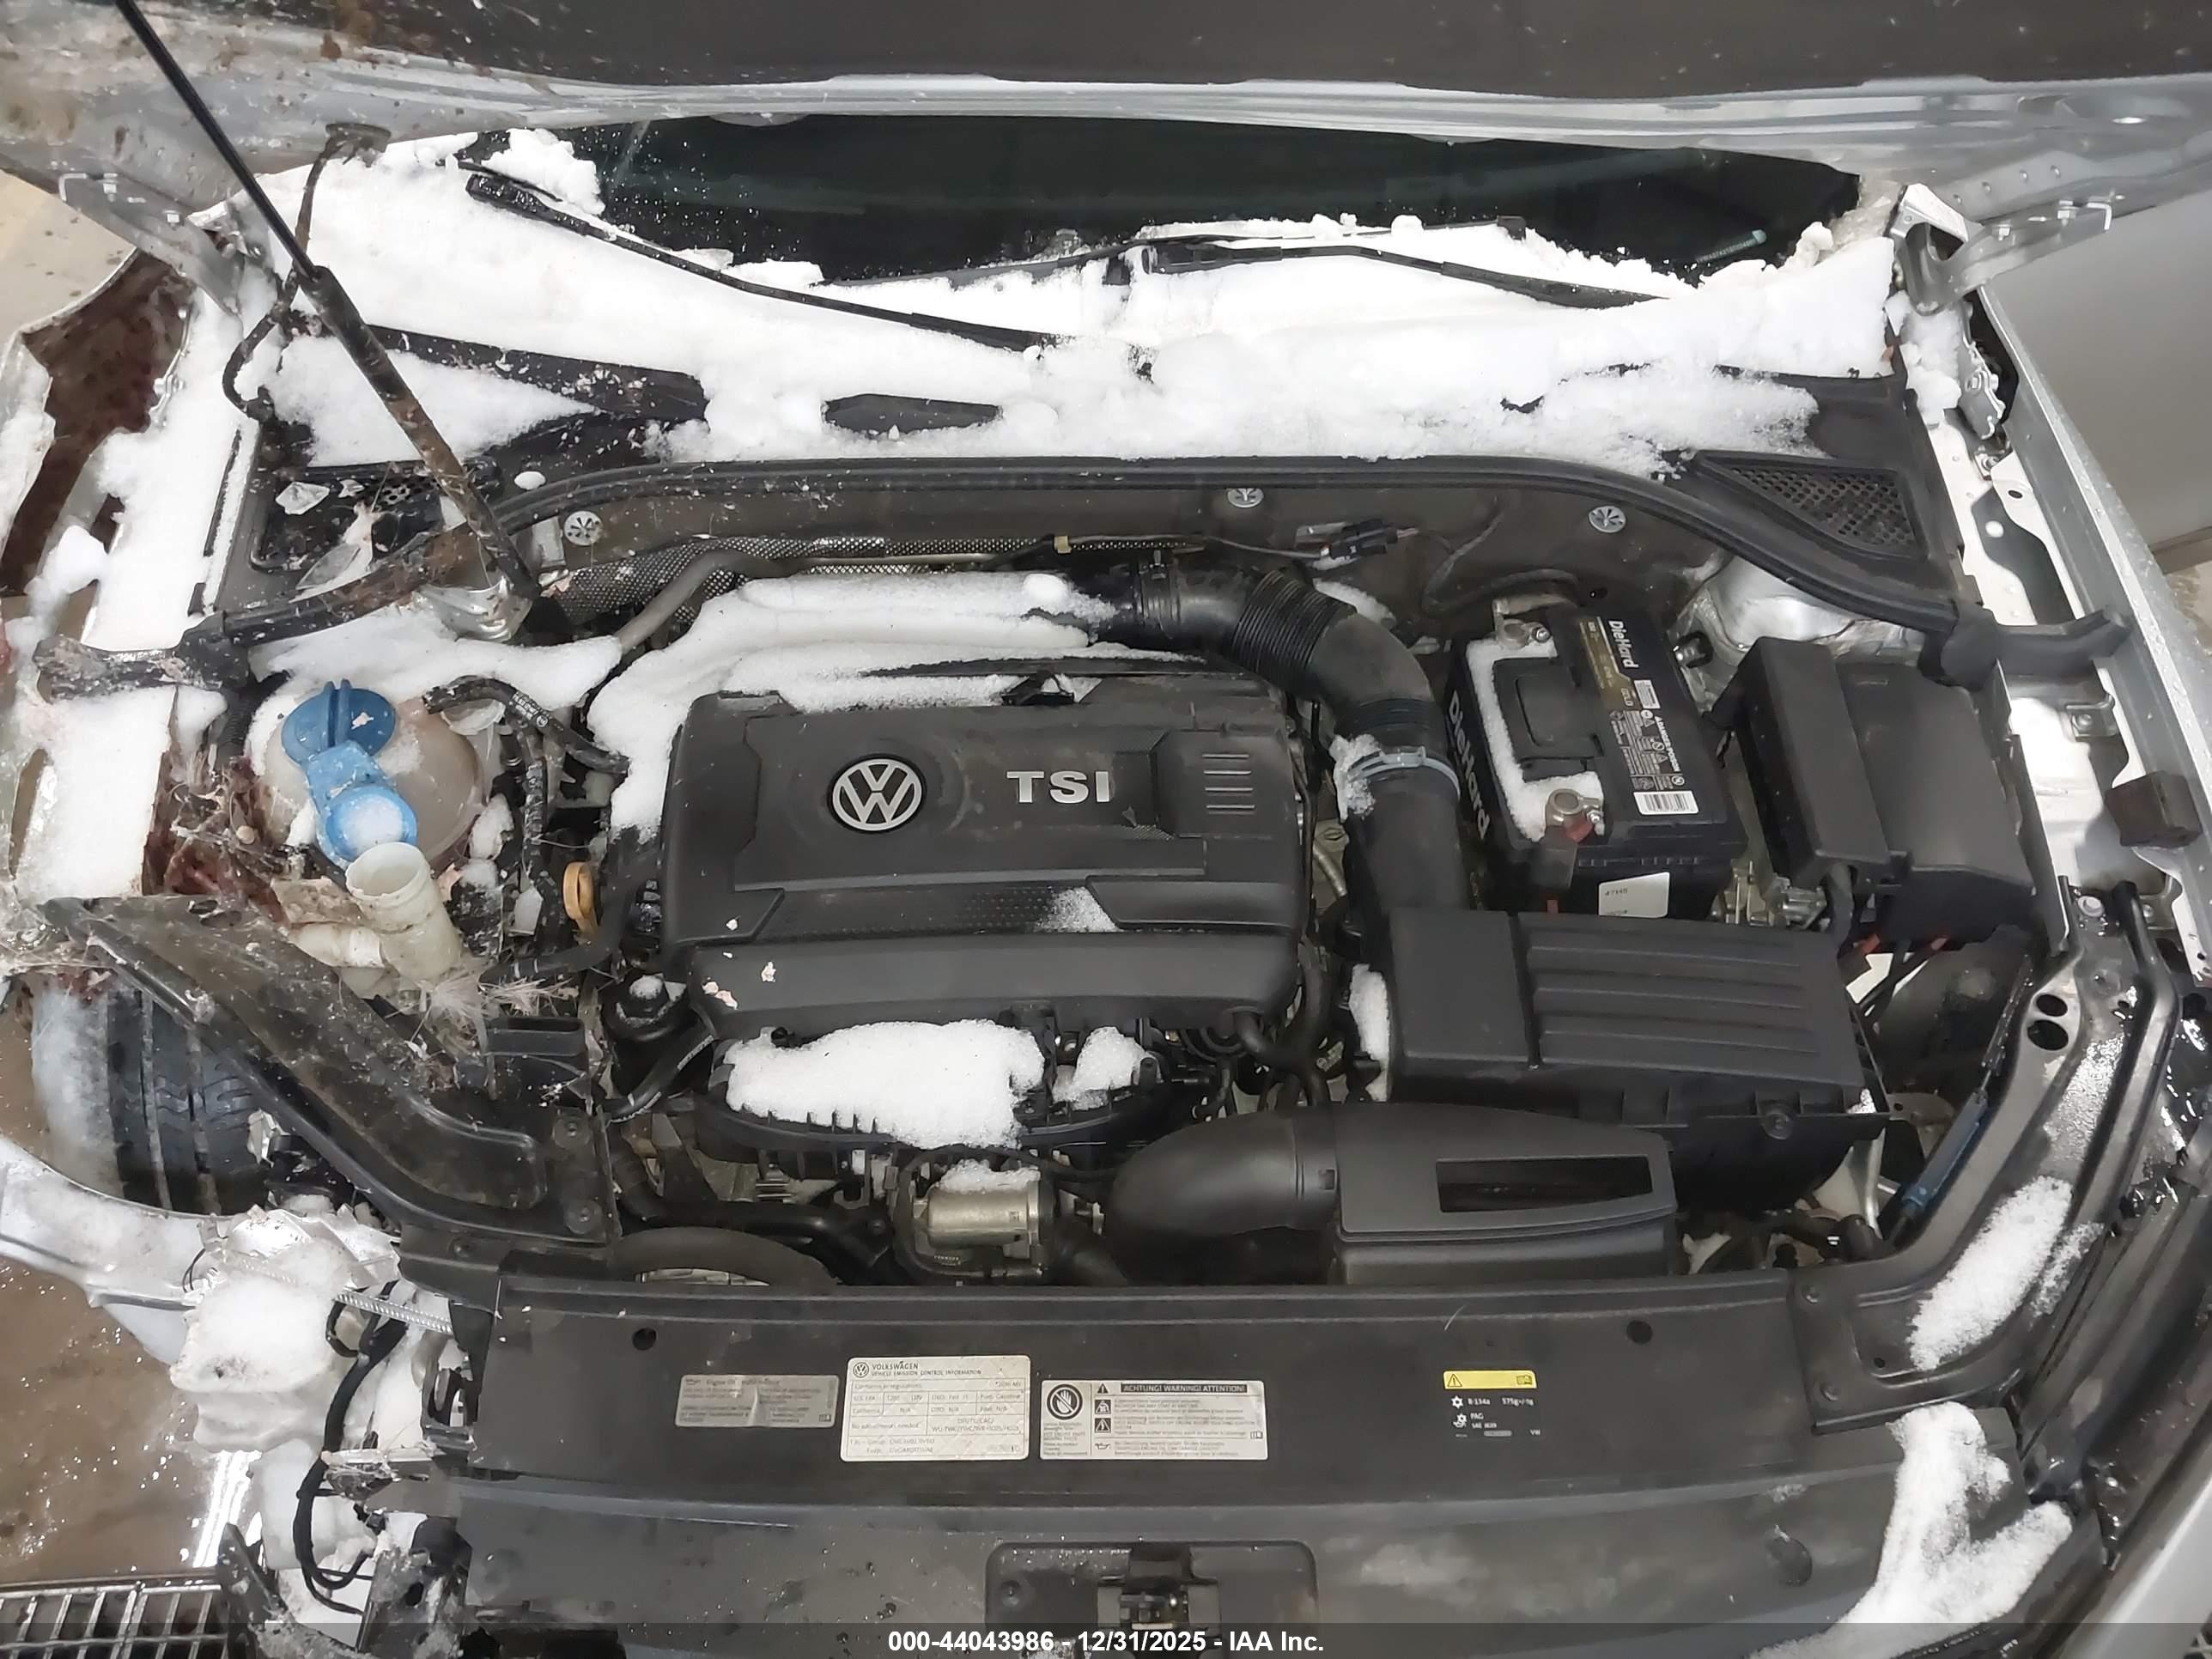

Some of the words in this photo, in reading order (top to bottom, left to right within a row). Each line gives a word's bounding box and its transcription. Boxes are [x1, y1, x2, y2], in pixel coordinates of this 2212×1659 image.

[1608, 620, 1639, 668] DieHard
[1006, 770, 1111, 804] TSI
[1448, 691, 1492, 841] DieHard
